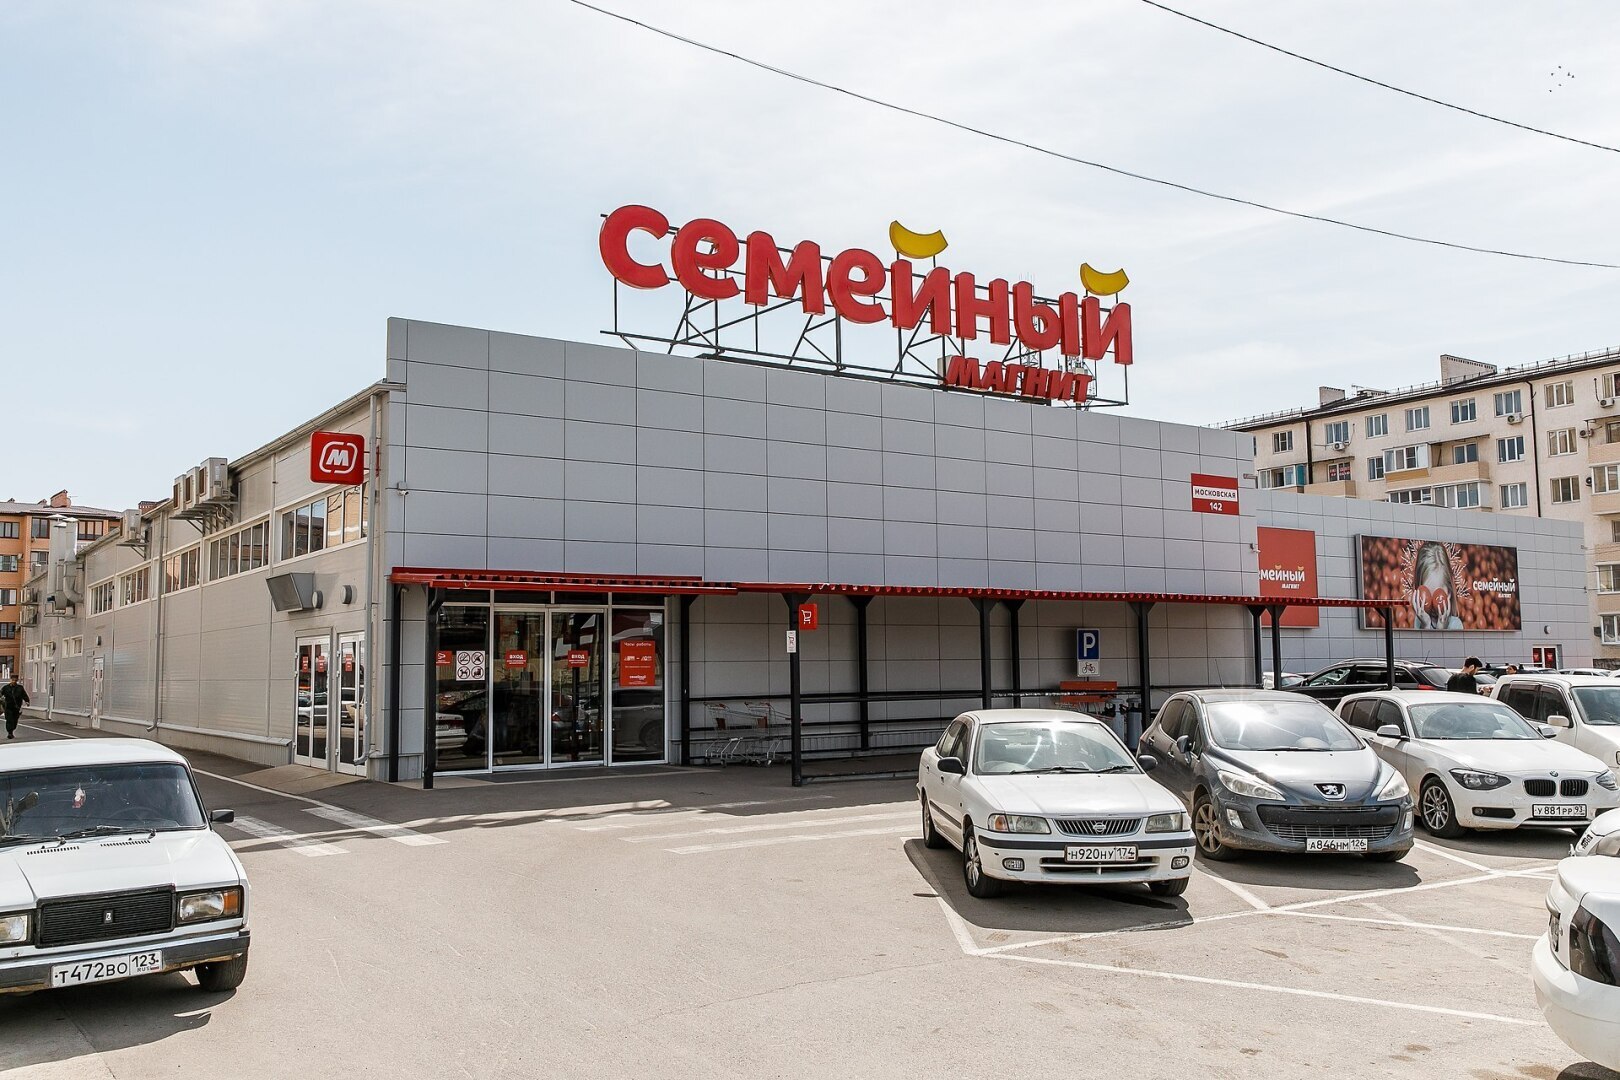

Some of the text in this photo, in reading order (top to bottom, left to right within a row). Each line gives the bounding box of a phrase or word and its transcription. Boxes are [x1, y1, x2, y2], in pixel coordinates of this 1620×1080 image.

[945, 355, 1093, 402] МАГНИТ
[1194, 488, 1236, 499] МОСКОВСКАЯ
[1209, 502, 1223, 511] 142
[1083, 632, 1096, 657] P
[1116, 847, 1135, 857] 174
[131, 953, 156, 968] 123
